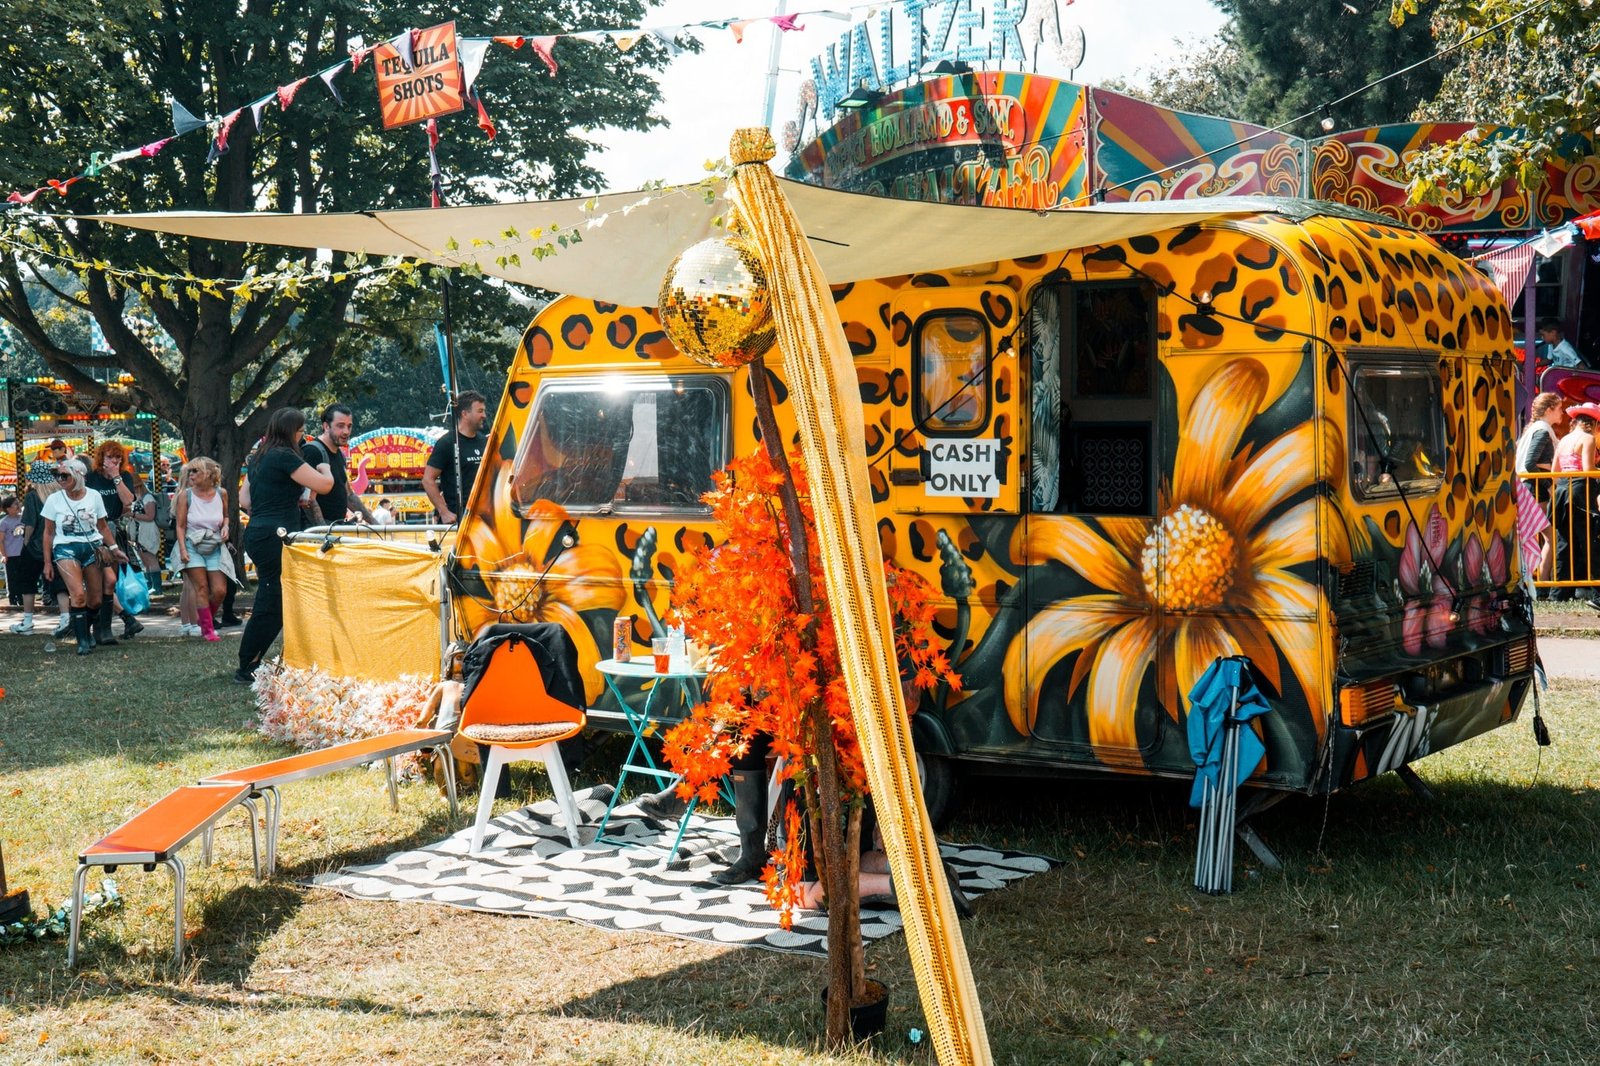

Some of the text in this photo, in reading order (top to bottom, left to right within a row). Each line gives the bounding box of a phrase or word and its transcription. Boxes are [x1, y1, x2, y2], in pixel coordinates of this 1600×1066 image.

[393, 73, 444, 102] SHOTS
[870, 103, 954, 157] HOLLAND
[956, 105, 969, 135] &
[358, 435, 430, 454] FAST TRACK
[932, 444, 990, 462] CASH
[351, 452, 431, 469] DODGEM
[931, 473, 992, 492] ONLY
